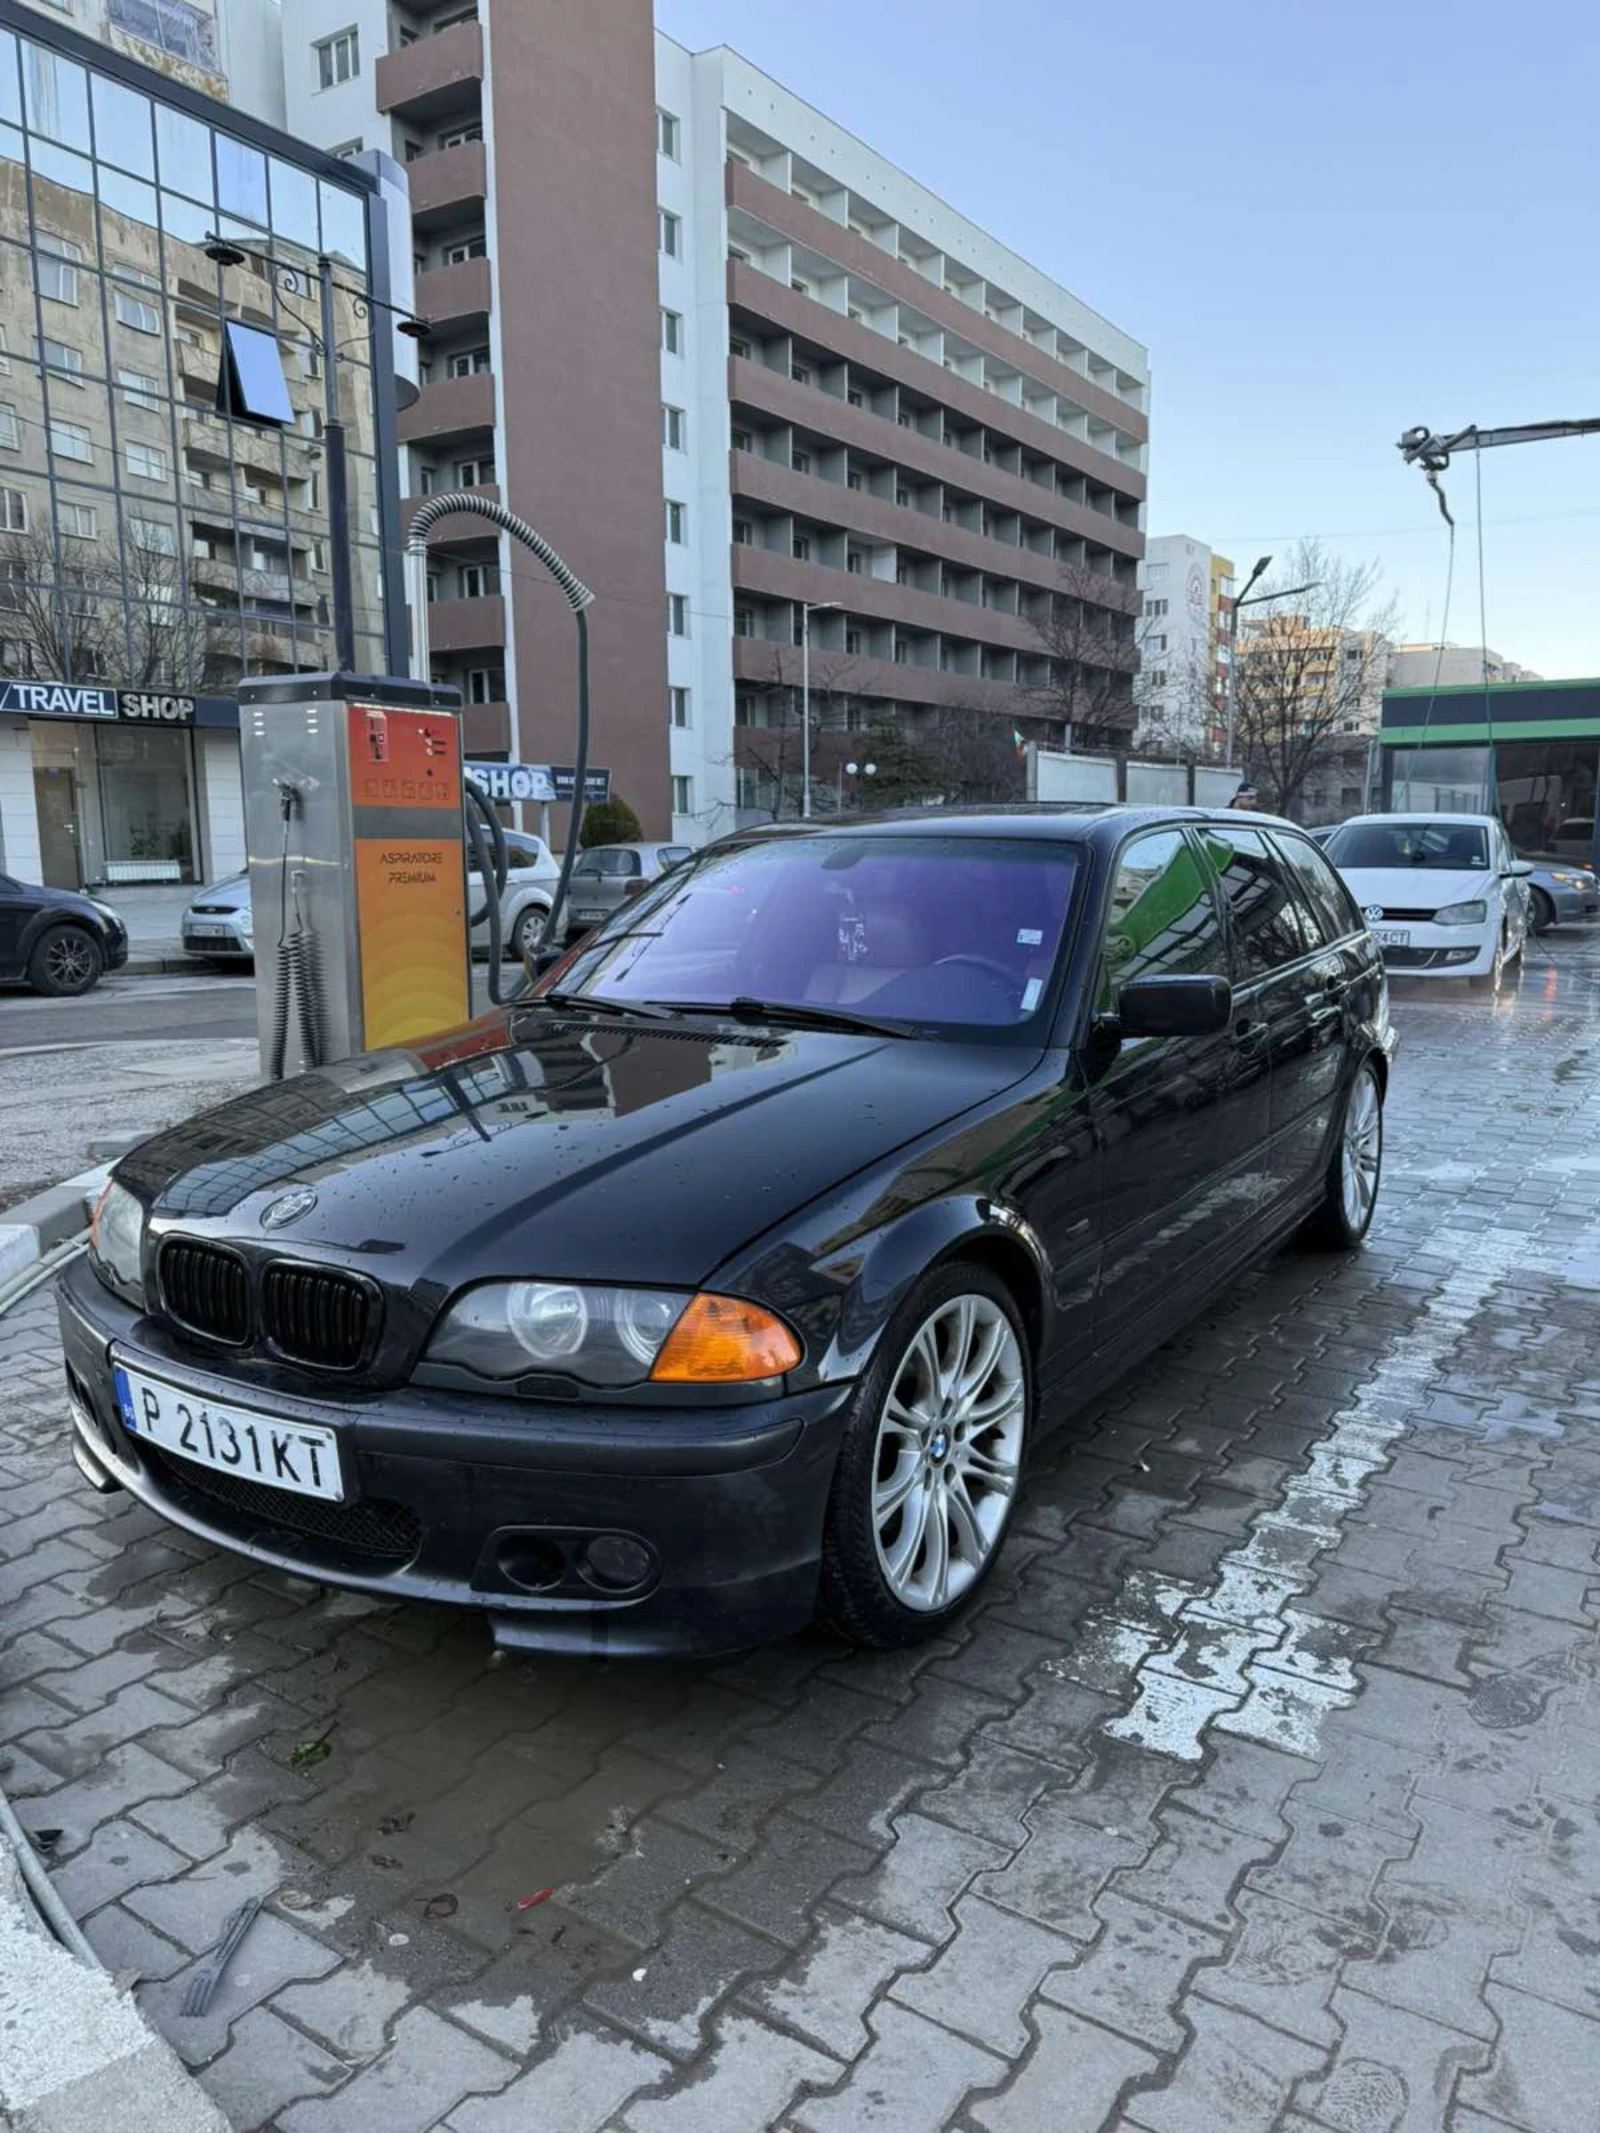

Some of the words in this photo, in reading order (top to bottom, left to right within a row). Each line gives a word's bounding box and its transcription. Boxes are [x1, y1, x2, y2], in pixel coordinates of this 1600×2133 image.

[12, 684, 114, 715] TRAVEL
[121, 693, 195, 721] SHOP
[471, 768, 548, 800] SHOP
[380, 852, 444, 865] ASPIRATORE
[388, 871, 437, 885] PREMIUM
